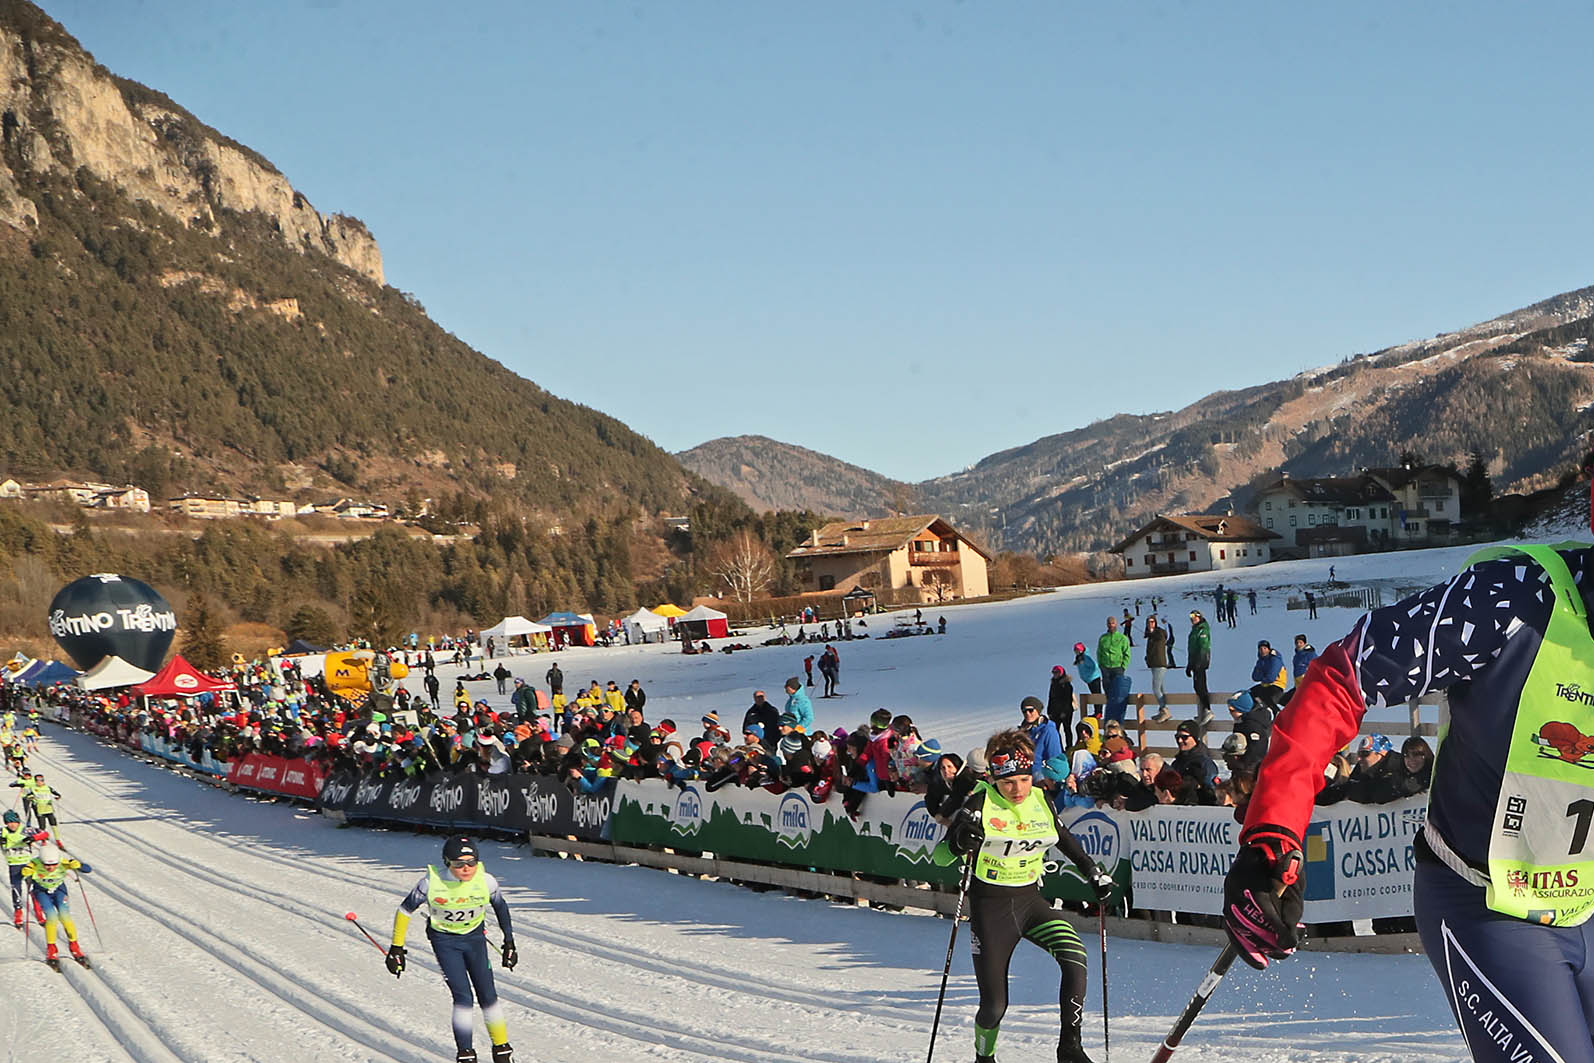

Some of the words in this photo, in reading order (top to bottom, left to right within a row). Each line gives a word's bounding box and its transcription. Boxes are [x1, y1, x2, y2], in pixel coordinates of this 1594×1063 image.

[521, 786, 558, 824] TRENTINO
[572, 793, 610, 828] TRENTINO
[678, 798, 699, 818] mila
[782, 804, 807, 829] mila
[904, 813, 936, 841] mila
[1130, 820, 1156, 843] VAL
[1158, 820, 1173, 843] DI
[1176, 820, 1232, 845] FIEMME
[1338, 815, 1373, 843] VAL
[1377, 811, 1397, 839] DI
[1131, 849, 1175, 873] CASSA
[1341, 847, 1401, 879] CASSA
[1159, 882, 1201, 894] COOPERATIVO
[1531, 869, 1579, 889] ITAS
[1342, 886, 1376, 899] CREDITO
[443, 910, 475, 922] 221
[1458, 980, 1481, 1015] S.C.
[1478, 1010, 1514, 1051] ALTA
